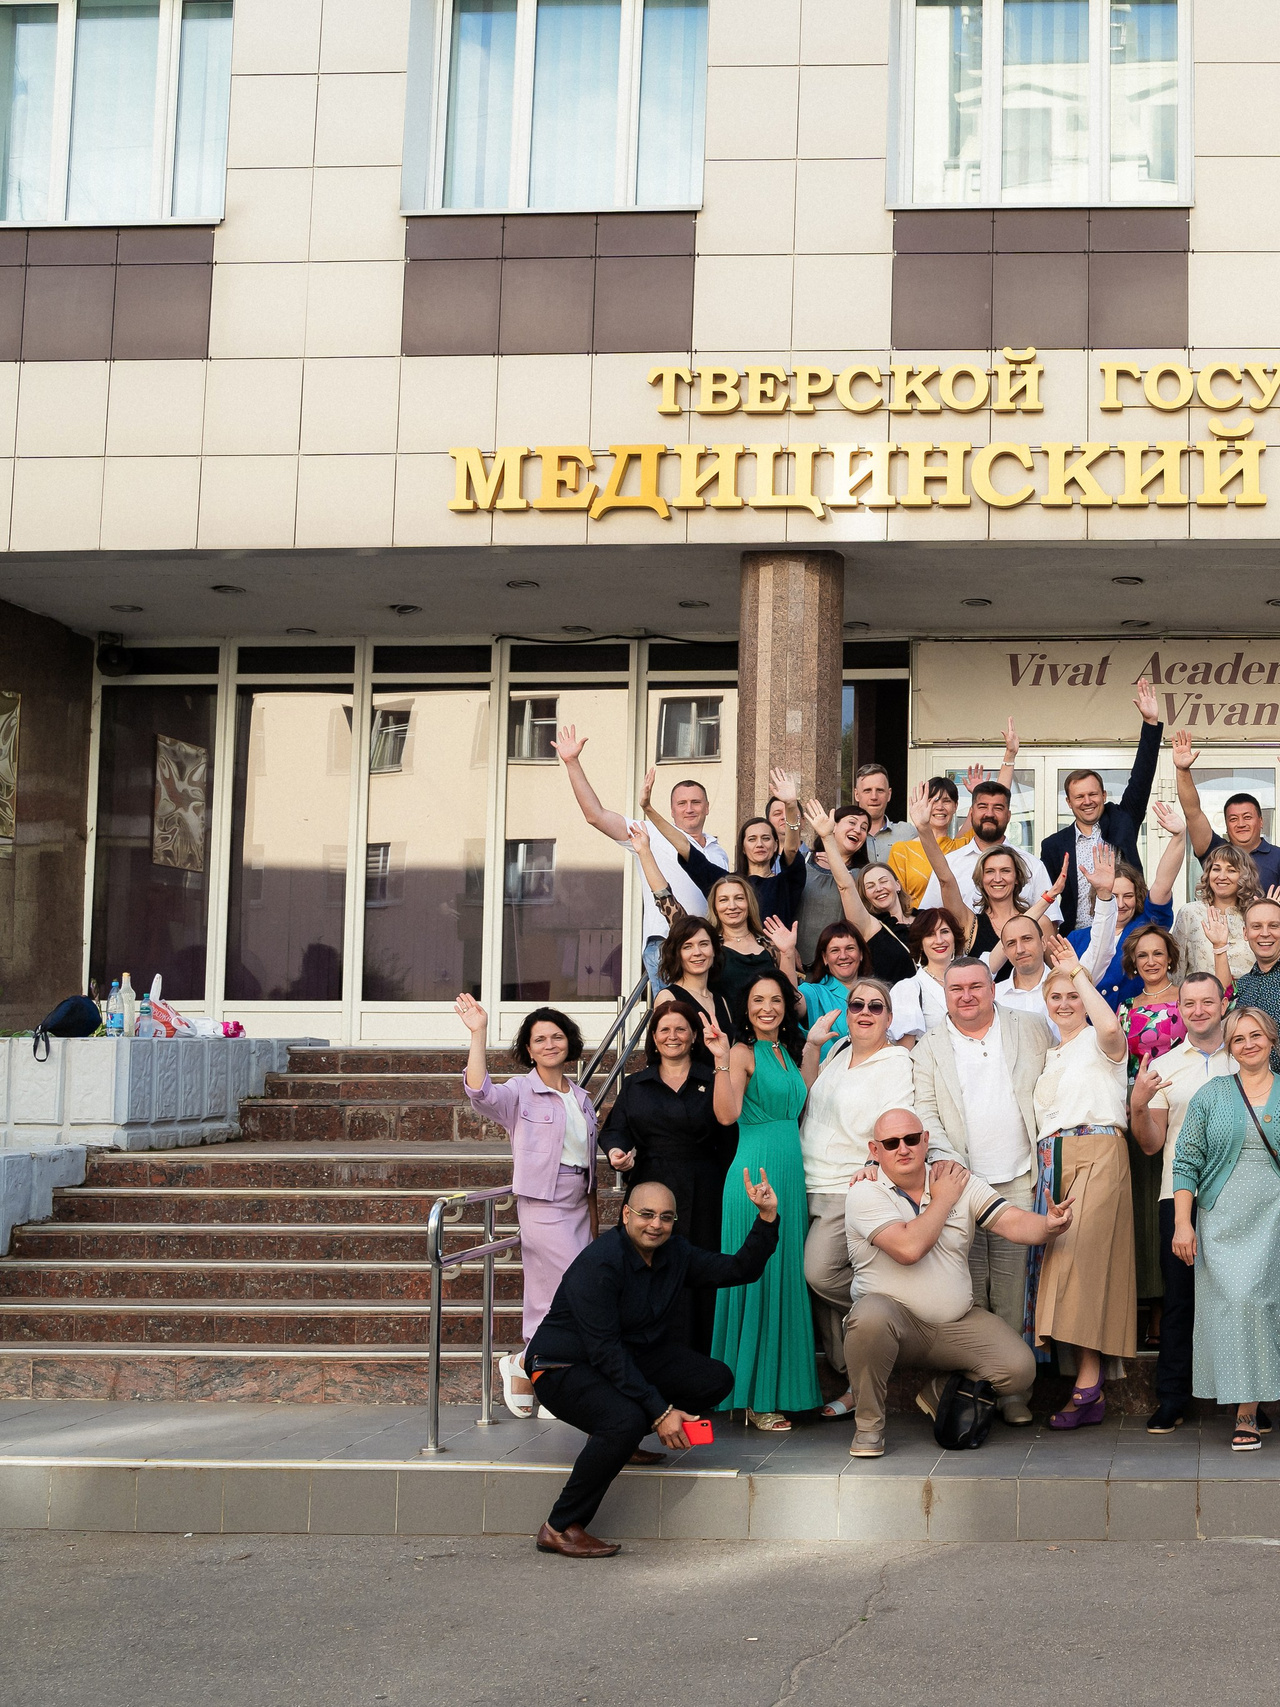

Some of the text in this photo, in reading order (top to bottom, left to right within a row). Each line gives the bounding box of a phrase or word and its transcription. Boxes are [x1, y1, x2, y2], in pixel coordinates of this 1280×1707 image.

[647, 346, 1044, 415] ТВЕРСКОЙ
[448, 418, 1268, 520] МЕДИЦИНСКИЙ
[1005, 653, 1112, 687] Vivat
